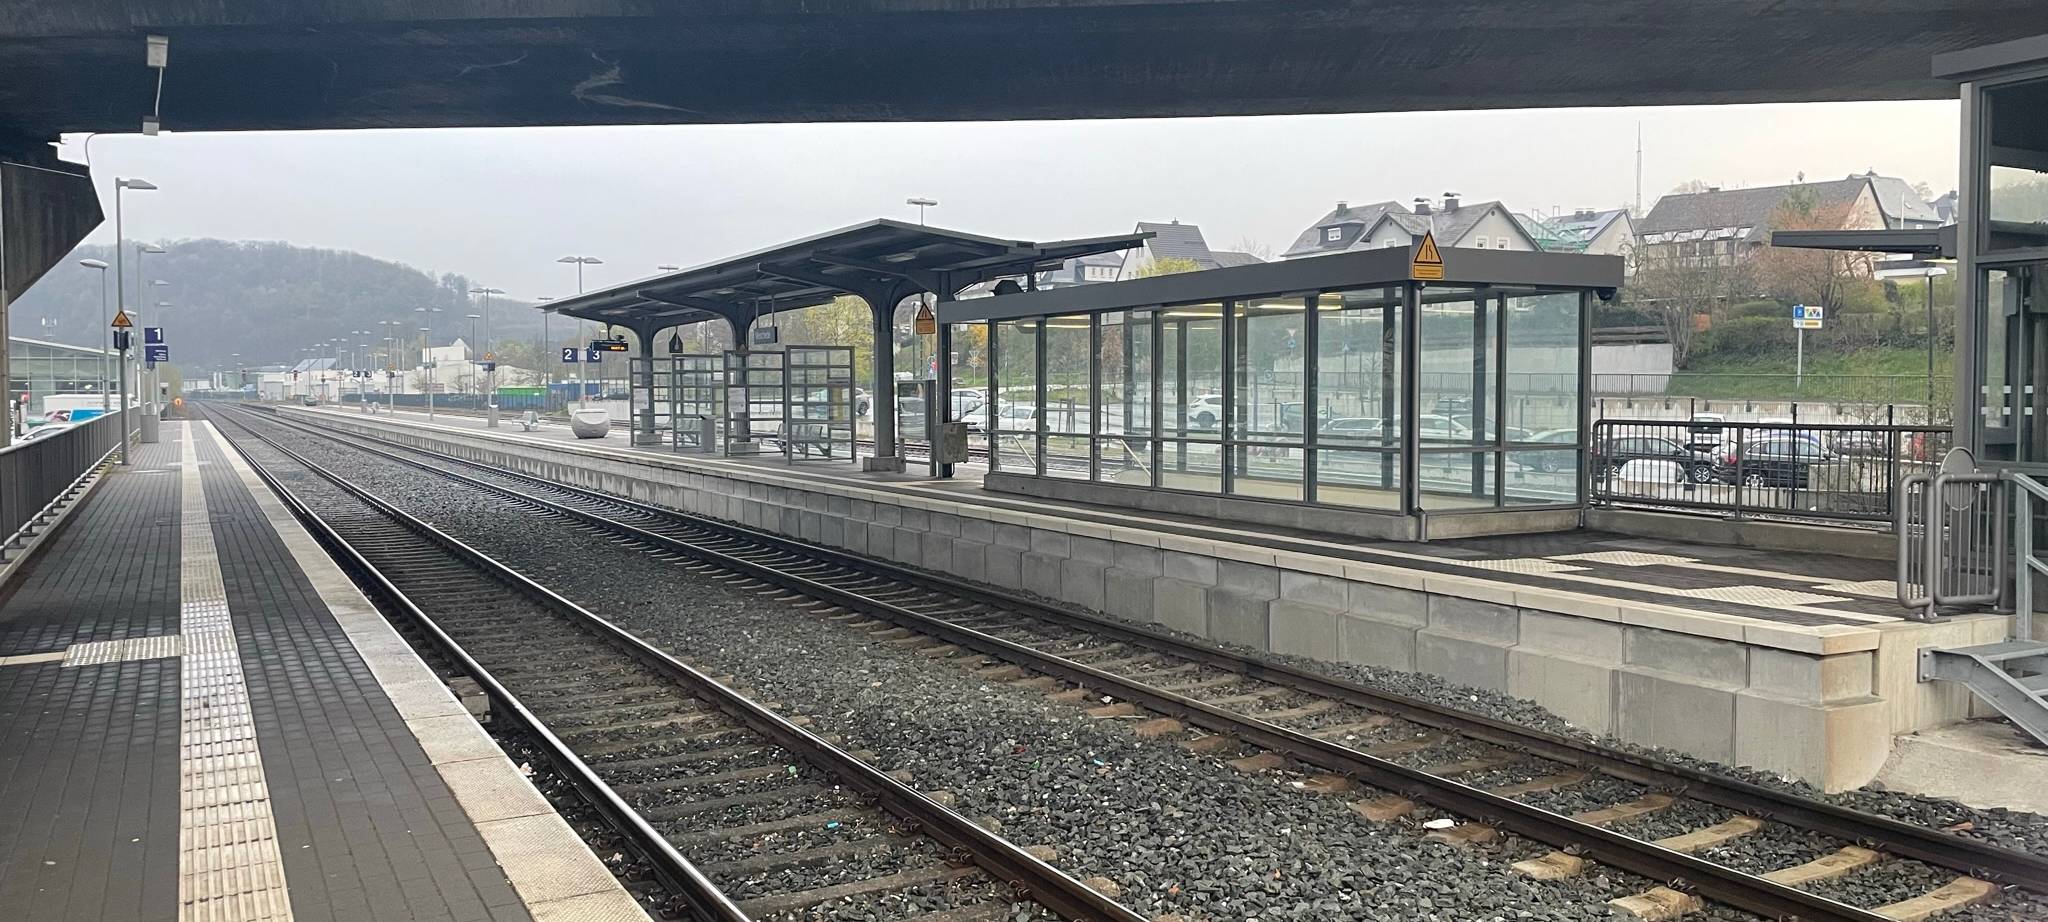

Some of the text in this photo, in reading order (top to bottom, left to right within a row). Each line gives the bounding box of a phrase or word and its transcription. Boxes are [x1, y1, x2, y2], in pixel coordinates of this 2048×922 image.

[153, 328, 161, 340] 1
[564, 349, 572, 360] 2
[592, 350, 600, 360] 3
